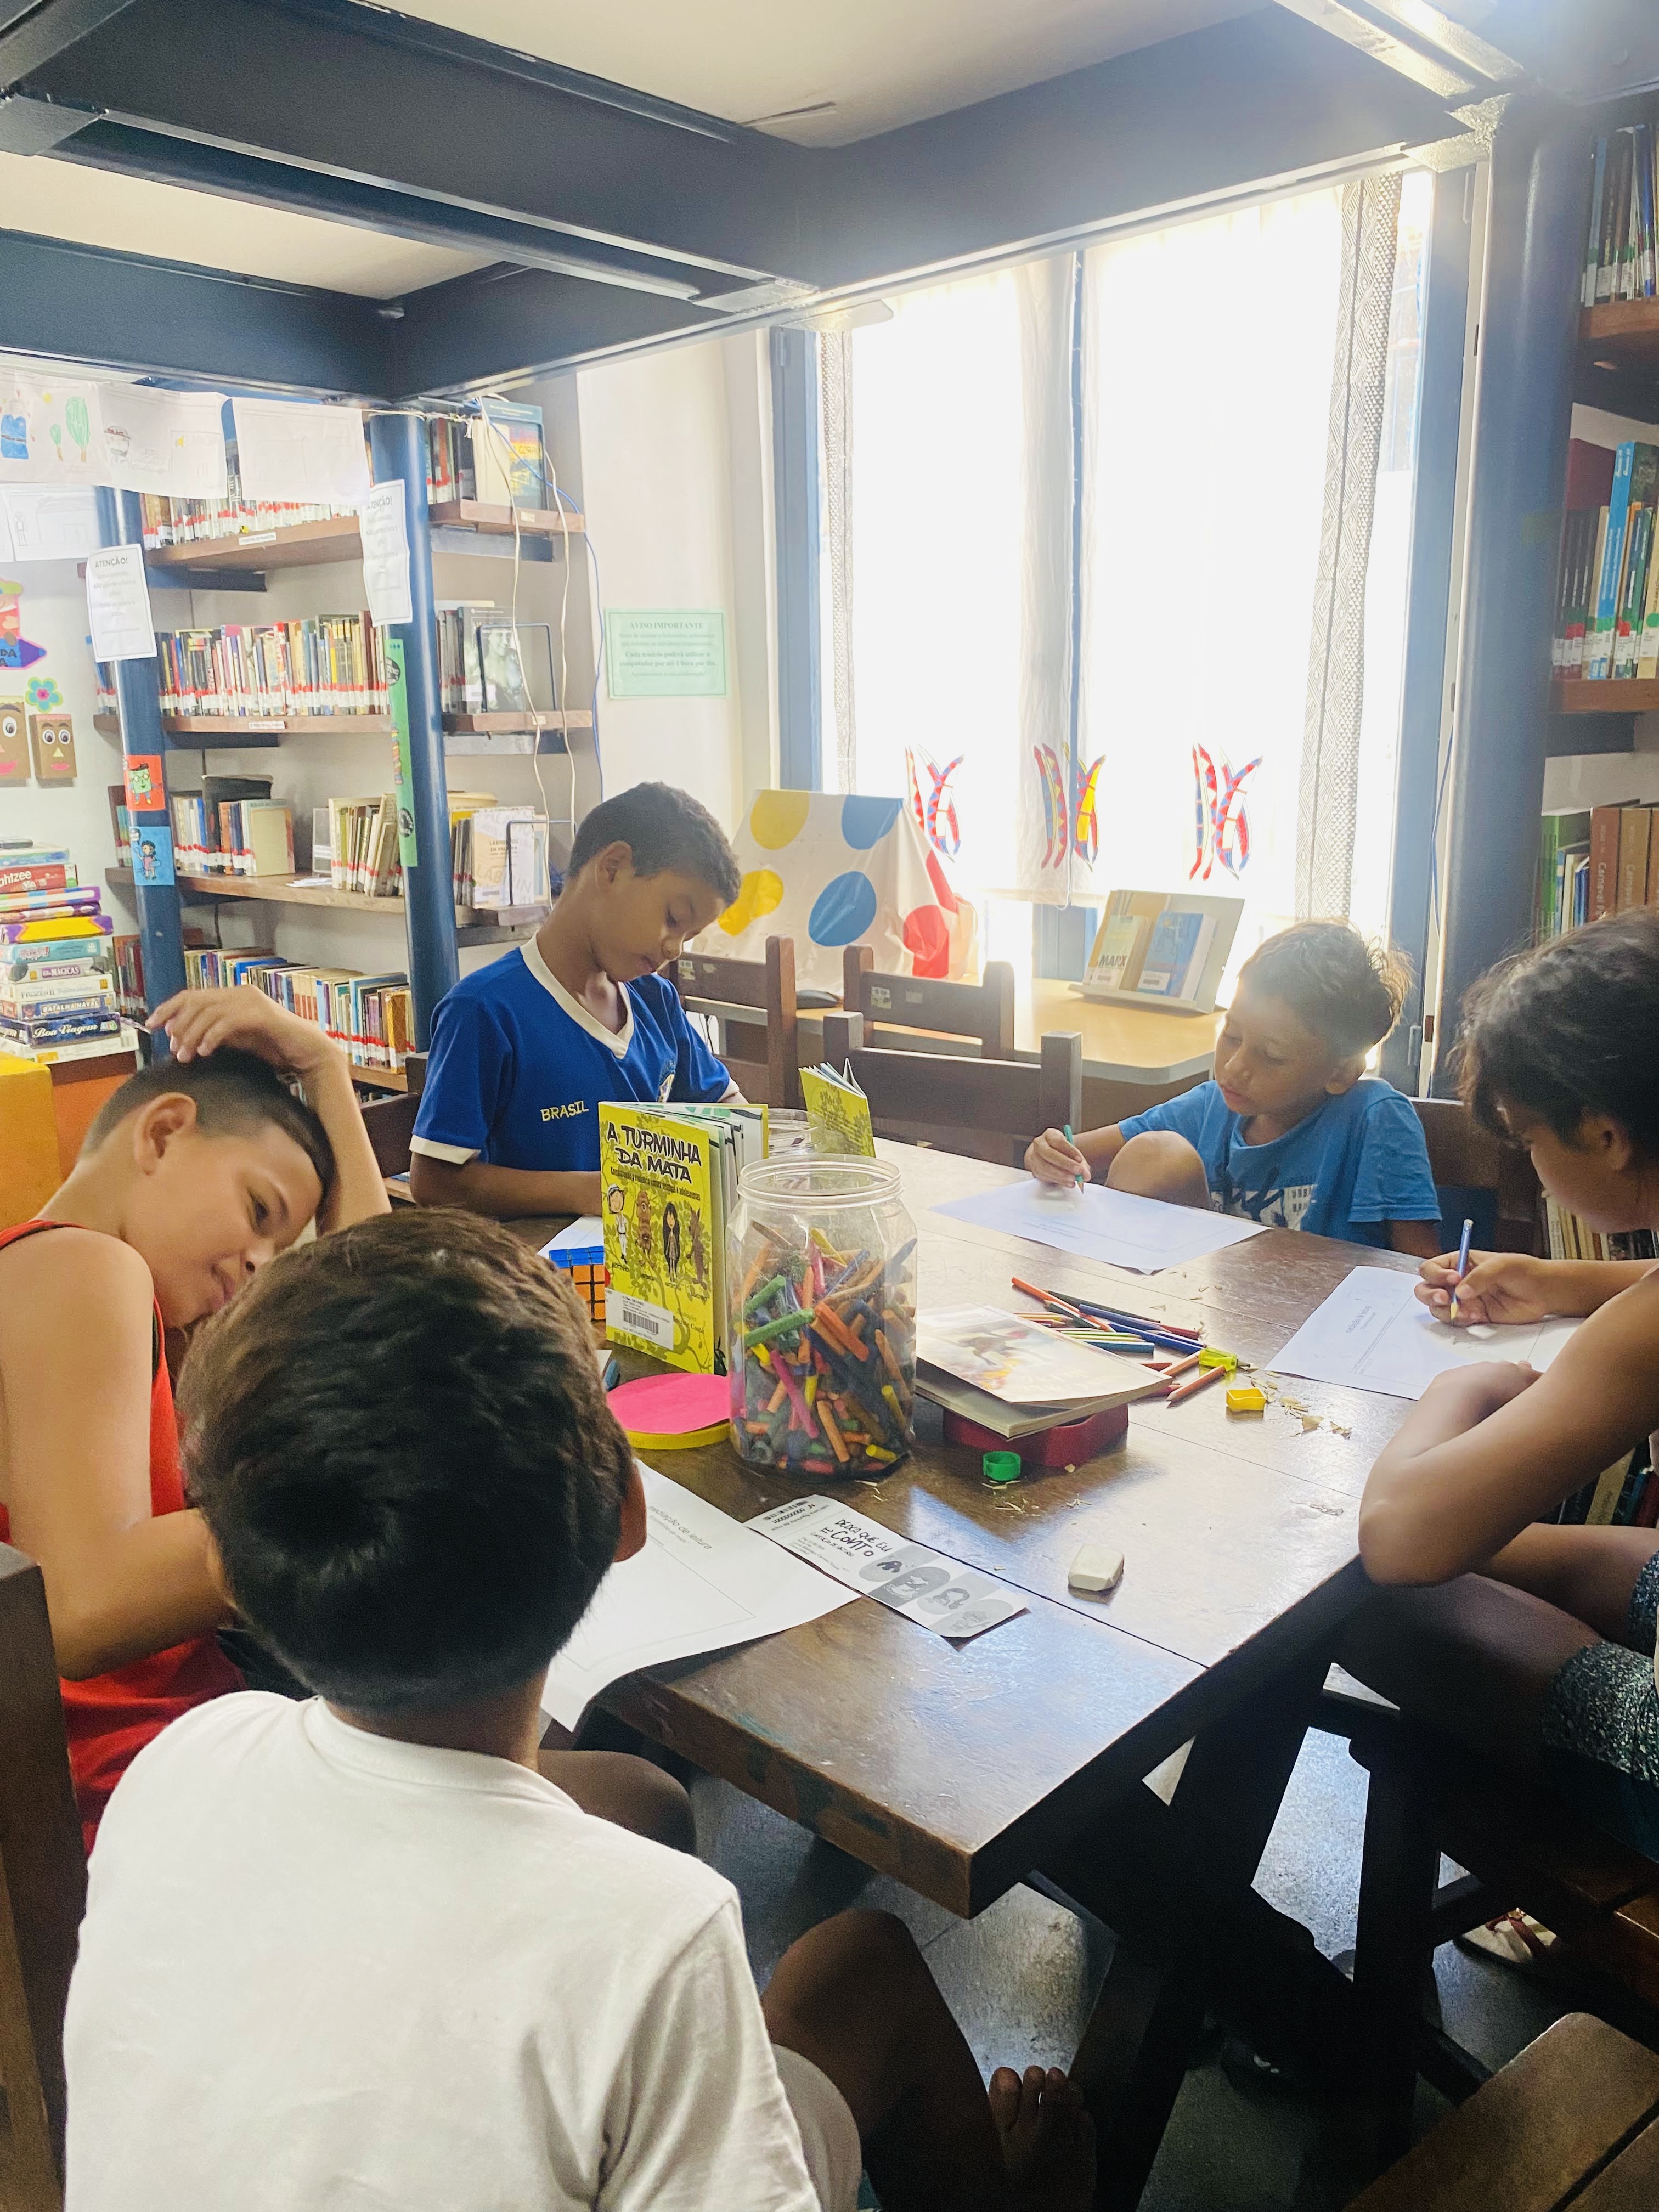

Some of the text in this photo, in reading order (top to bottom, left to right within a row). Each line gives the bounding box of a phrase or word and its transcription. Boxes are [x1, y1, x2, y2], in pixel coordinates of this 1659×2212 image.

[95, 557, 128, 568] ATENÇÃO!
[1098, 955, 1127, 967] MARX
[42, 1001, 99, 1013] BATALHA NAVAL
[33, 1027, 58, 1038] Boa
[59, 1024, 98, 1035] Viagem
[540, 1100, 589, 1122] BRASIL
[607, 1122, 702, 1167] A TURMINHA
[615, 1147, 692, 1184] DA MATA
[819, 1527, 834, 1535] TE
[834, 1519, 893, 1553] DEIXA QUE EU
